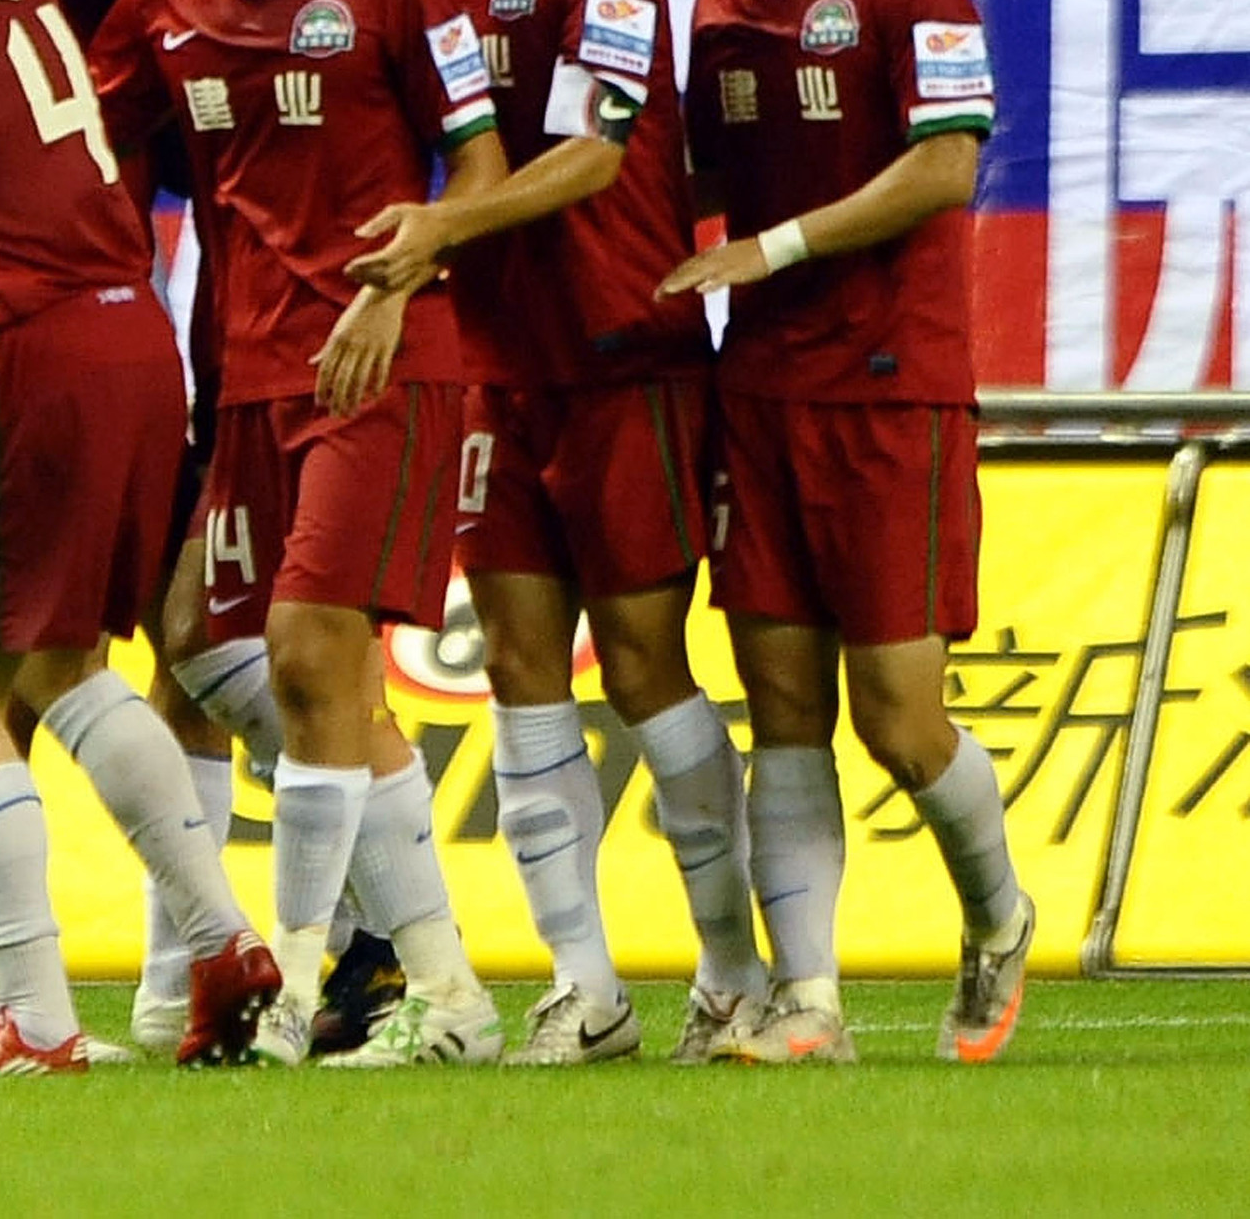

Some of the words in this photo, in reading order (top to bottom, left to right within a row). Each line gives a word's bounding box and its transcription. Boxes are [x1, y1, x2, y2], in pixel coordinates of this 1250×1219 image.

[6, 2, 120, 186] 4
[182, 70, 325, 132] 建业
[204, 505, 256, 587] 14
